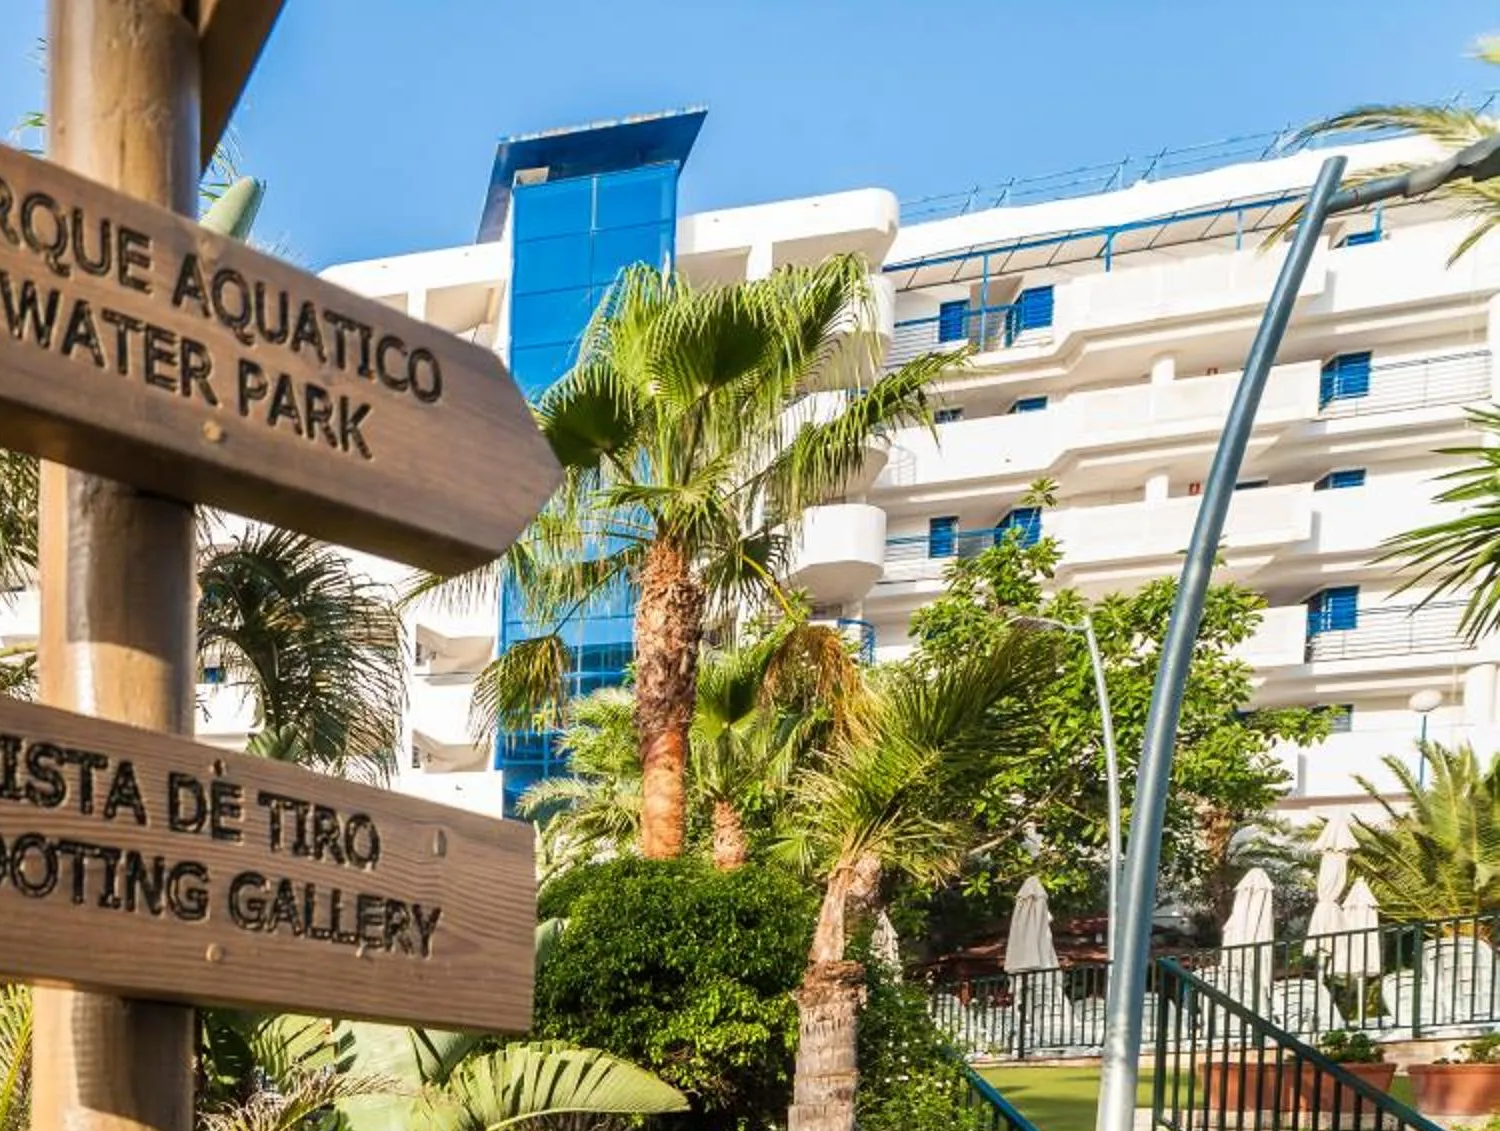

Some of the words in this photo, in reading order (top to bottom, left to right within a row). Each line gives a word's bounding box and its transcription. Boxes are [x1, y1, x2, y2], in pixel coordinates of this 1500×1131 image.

[171, 251, 444, 405] AQUATICO
[237, 358, 374, 461] PARK
[165, 770, 243, 843] DE
[258, 789, 382, 871] TIRO
[228, 871, 443, 960] GALLERY
